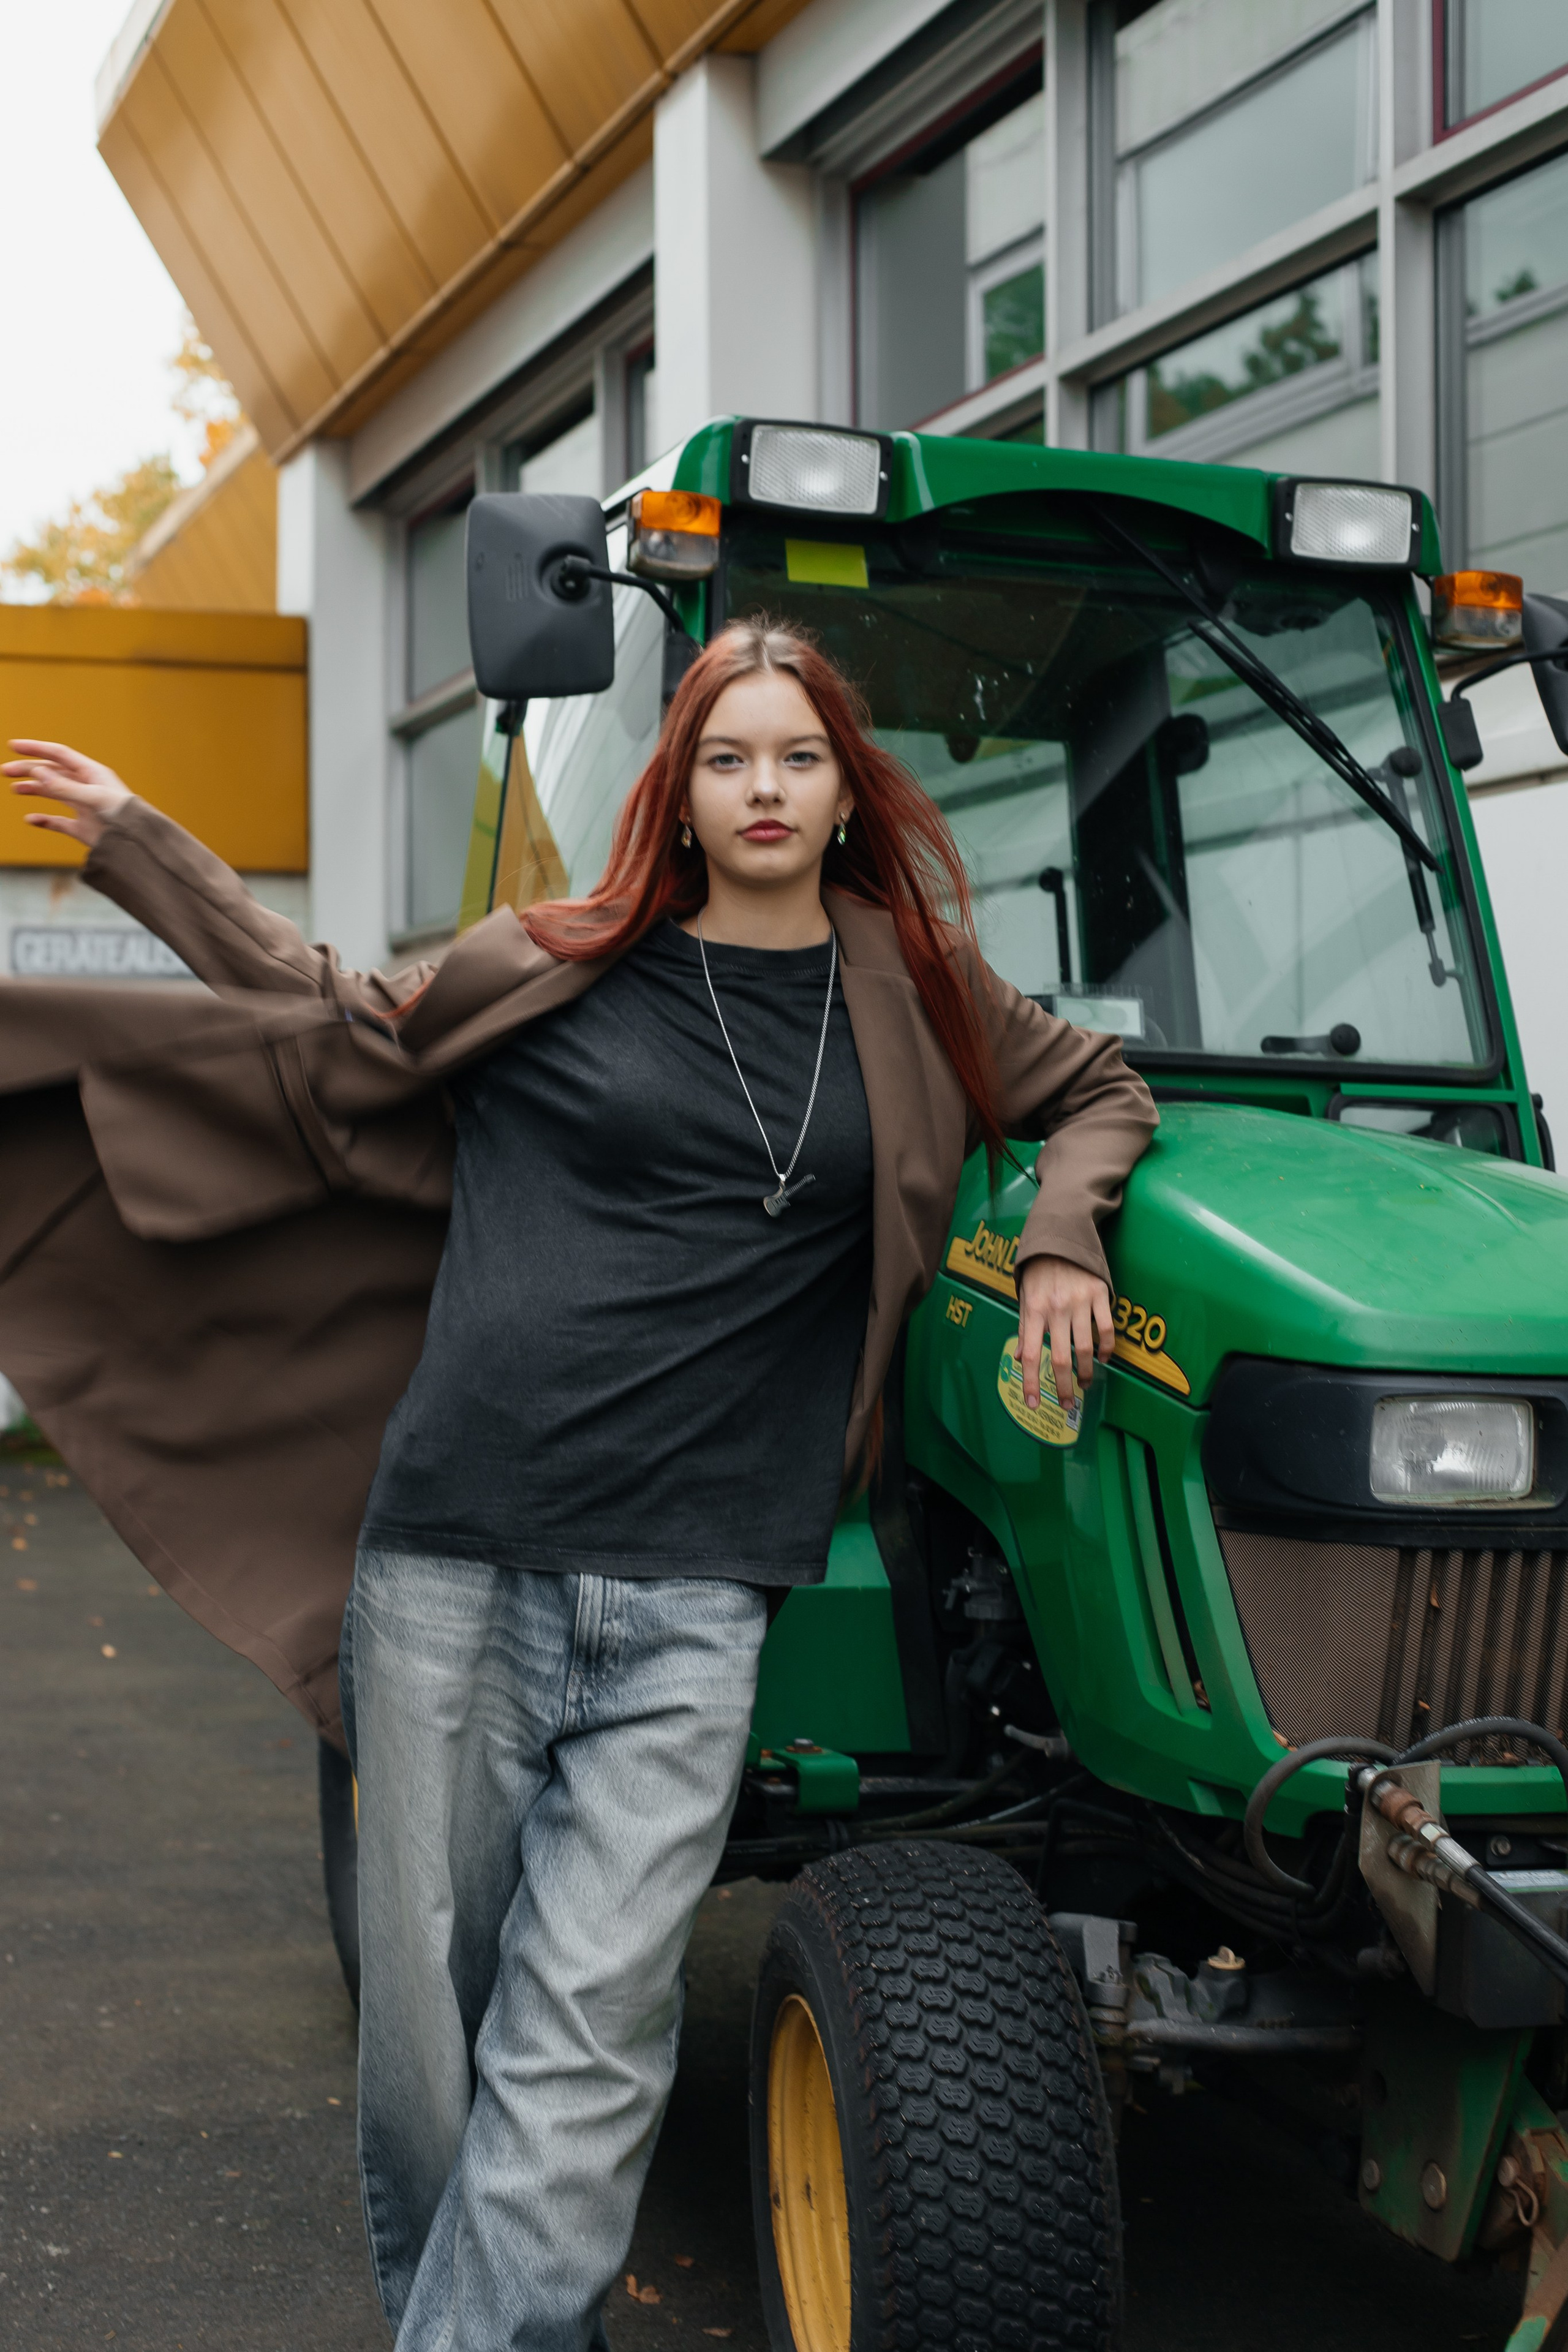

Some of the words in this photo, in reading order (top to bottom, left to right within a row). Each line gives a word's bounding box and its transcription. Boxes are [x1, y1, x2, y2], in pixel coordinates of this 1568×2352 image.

[965, 1219, 1010, 1268] JOHN
[946, 1294, 973, 1328] HST
[1111, 1295, 1167, 1349] 320
